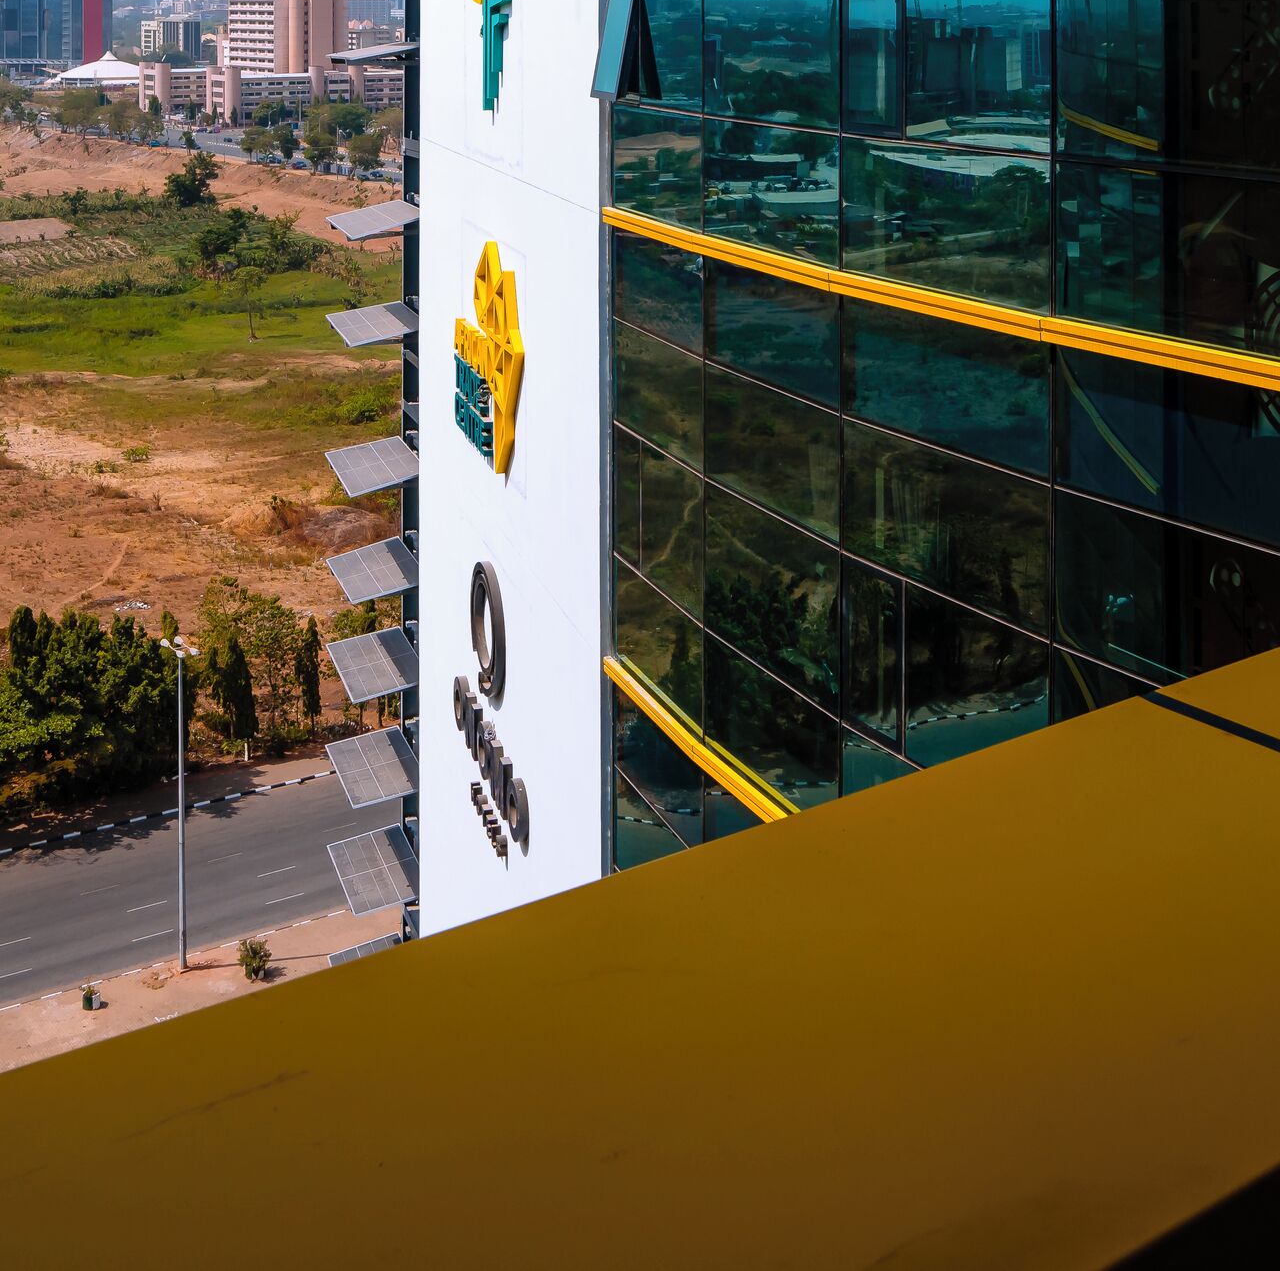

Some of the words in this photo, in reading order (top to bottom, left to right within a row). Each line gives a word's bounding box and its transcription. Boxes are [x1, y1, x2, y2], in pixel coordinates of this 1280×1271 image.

[454, 318, 488, 379] AFRICAN
[454, 353, 490, 417] TRADE
[455, 392, 494, 457] CENTRE
[453, 676, 528, 842] ONOMO
